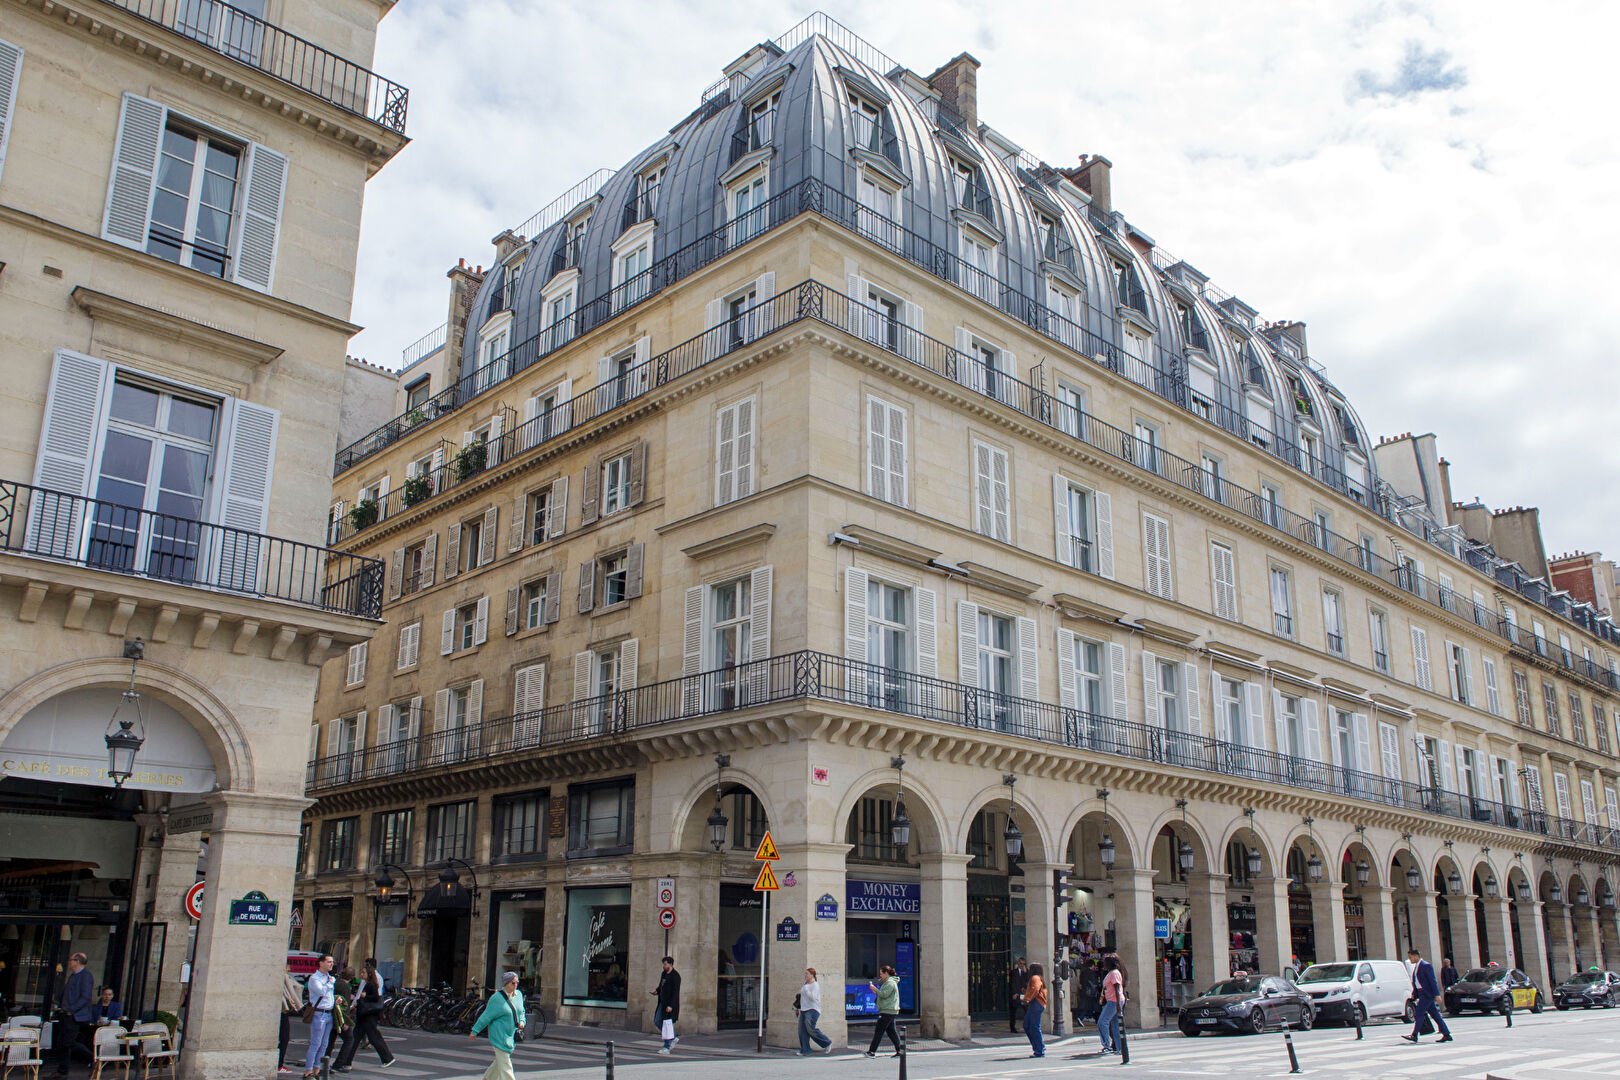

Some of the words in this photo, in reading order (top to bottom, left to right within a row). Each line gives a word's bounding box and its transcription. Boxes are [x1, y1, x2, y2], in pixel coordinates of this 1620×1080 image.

[3, 760, 51, 775] CAFÉ
[57, 764, 90, 777] DES
[863, 883, 908, 897] MONEY
[851, 897, 920, 912] EXCHANGE
[249, 913, 268, 921] RIVOLI
[589, 911, 606, 942] Café
